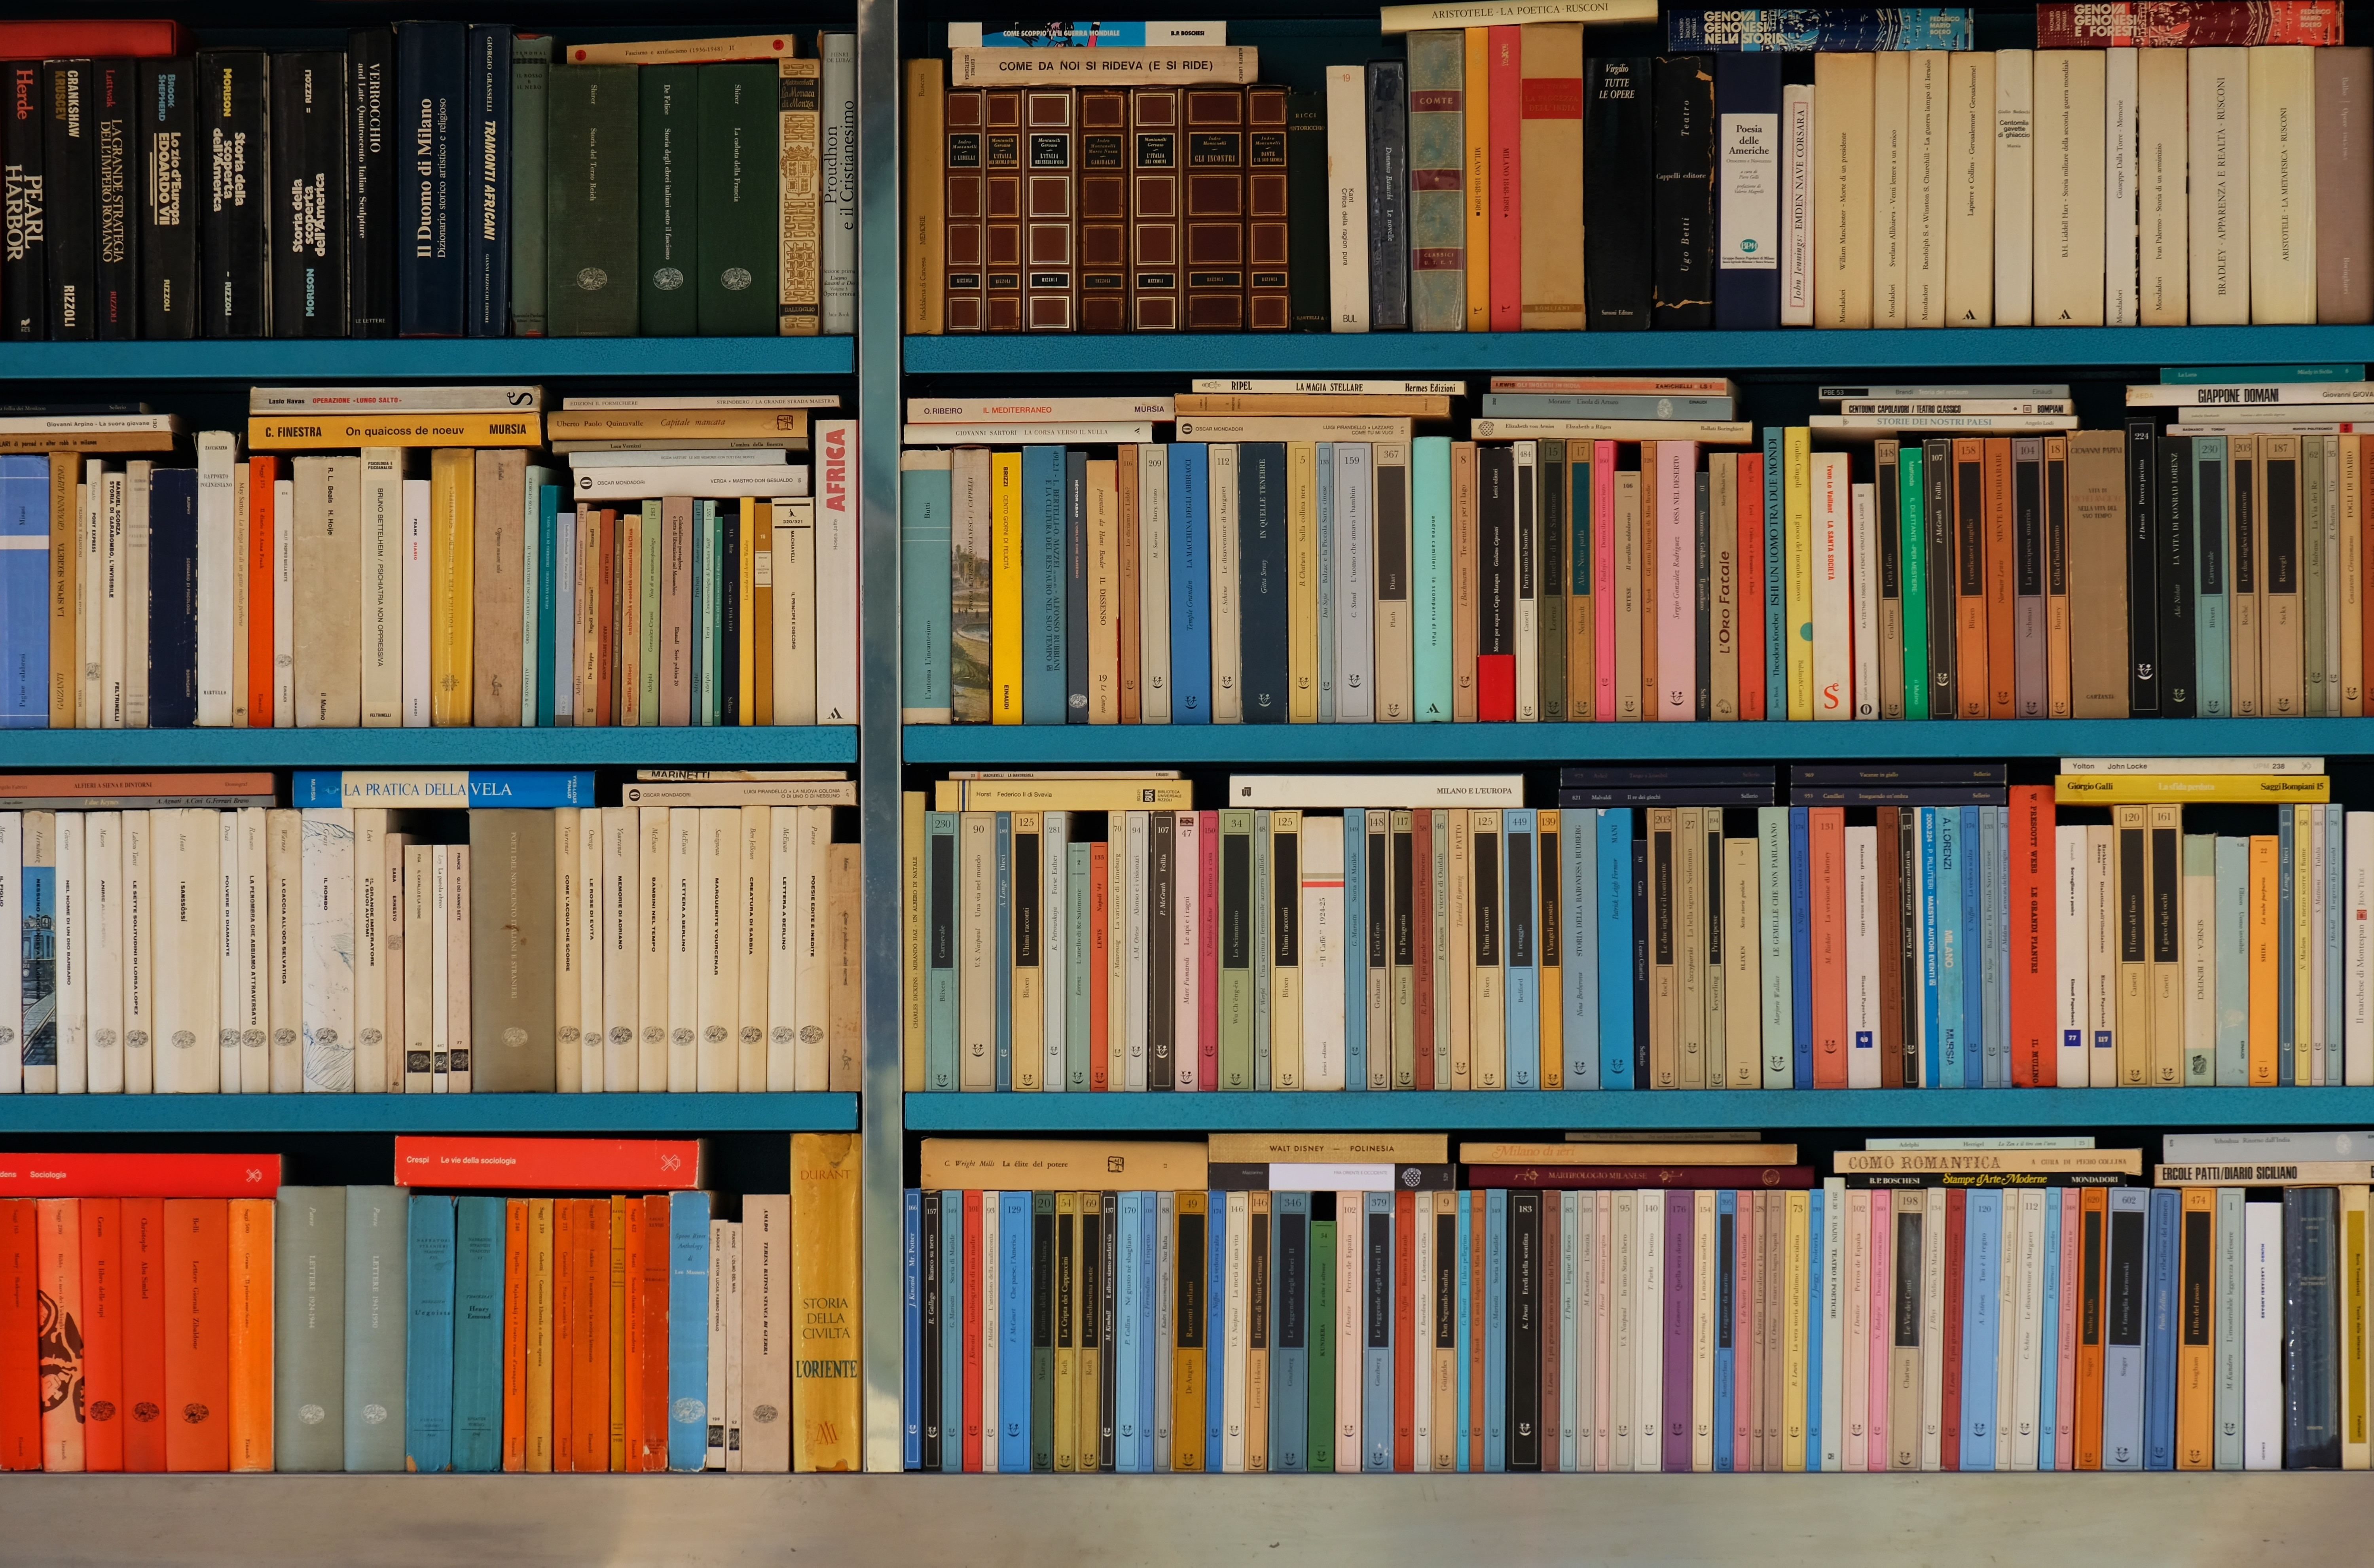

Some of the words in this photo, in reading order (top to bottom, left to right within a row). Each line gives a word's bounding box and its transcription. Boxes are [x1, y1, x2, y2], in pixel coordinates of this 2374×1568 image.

[1432, 8, 1494, 19] ARISTOTELE
[1500, 7, 1513, 15] LA
[1517, 6, 1560, 15] POETICA
[1566, 3, 1608, 12] RUSCONI
[999, 61, 1032, 71] COME
[1039, 61, 1054, 70] DA
[1060, 61, 1080, 70] NOI
[1086, 61, 1096, 70] SI
[1102, 61, 1143, 70] RIDEVA
[1149, 61, 1160, 72] (E
[1166, 61, 1176, 70] SI
[1183, 61, 1213, 72] RIDE)
[1606, 63, 1629, 75] Virgilio
[664, 84, 671, 94] De
[1605, 78, 1630, 87] TUTTE
[16, 69, 34, 119] Herde
[55, 71, 66, 120] KRUSCEV
[158, 74, 167, 121] SHEPHERD
[167, 74, 176, 108] BROOK-
[223, 68, 232, 117] MORISON
[1599, 90, 1608, 99] LE
[1610, 90, 1635, 99] OPERE
[67, 70, 80, 138] CRANKSHAW
[370, 63, 381, 153] VERROCCHIO
[417, 98, 432, 156] Milano
[1736, 125, 1762, 133] Poesia
[1739, 136, 1759, 144] delle
[484, 120, 496, 182] TRAMONTI
[840, 100, 854, 205] Cristianesimo
[1729, 146, 1769, 154] Americhe
[417, 161, 432, 176] di
[823, 126, 838, 205] Proudhon
[5, 164, 24, 261] HARBOR
[24, 175, 44, 249] PEARL
[417, 181, 432, 241] Duomo
[484, 184, 495, 241] AFRICANI
[840, 207, 853, 216] il
[2217, 181, 2226, 241] APPARENZA
[417, 245, 431, 258] Il
[2218, 248, 2227, 296] BRADLEY
[64, 285, 75, 327] RIZZOLI
[1343, 314, 1358, 323] BUL
[1231, 381, 1253, 391] RIPEL
[1296, 383, 1305, 391] LA
[1305, 382, 1327, 392] MAGIA
[1329, 382, 1363, 392] STELLARE
[2198, 389, 2240, 403] GIAPPONE
[2244, 388, 2279, 402] DOMANI
[265, 427, 274, 437] C.
[278, 426, 322, 437] FINESTRA
[346, 427, 360, 436] On
[364, 426, 411, 437] quaicoss
[415, 426, 429, 435] de
[489, 424, 526, 434] MURSIA
[826, 428, 845, 512] AFRICA
[1259, 497, 1268, 528] QUELLE
[344, 784, 360, 796] LA
[366, 783, 419, 796] PRATICA
[425, 783, 466, 795] DELLA
[470, 783, 512, 795] VELA
[2067, 782, 2094, 791] Giorgio
[935, 820, 951, 828] 230
[2125, 813, 2140, 822] 120
[2031, 887, 2038, 898] LE
[1943, 930, 1953, 968] MILANO
[406, 1156, 429, 1165] Crespi
[481, 1157, 516, 1166] sociologia
[1848, 1155, 1895, 1169] COMO
[1901, 1156, 2000, 1169] ROMANTICA
[30, 1171, 66, 1180] Sociologia
[801, 1168, 850, 1180] DURANT
[2162, 1167, 2192, 1181] ERCOLE
[2256, 1166, 2297, 1180] SICILIANO
[2191, 1196, 2205, 1204] 474
[803, 1297, 848, 1309] STORIA
[807, 1312, 845, 1324] DELLA
[796, 1360, 857, 1378] L'ORIENTE
